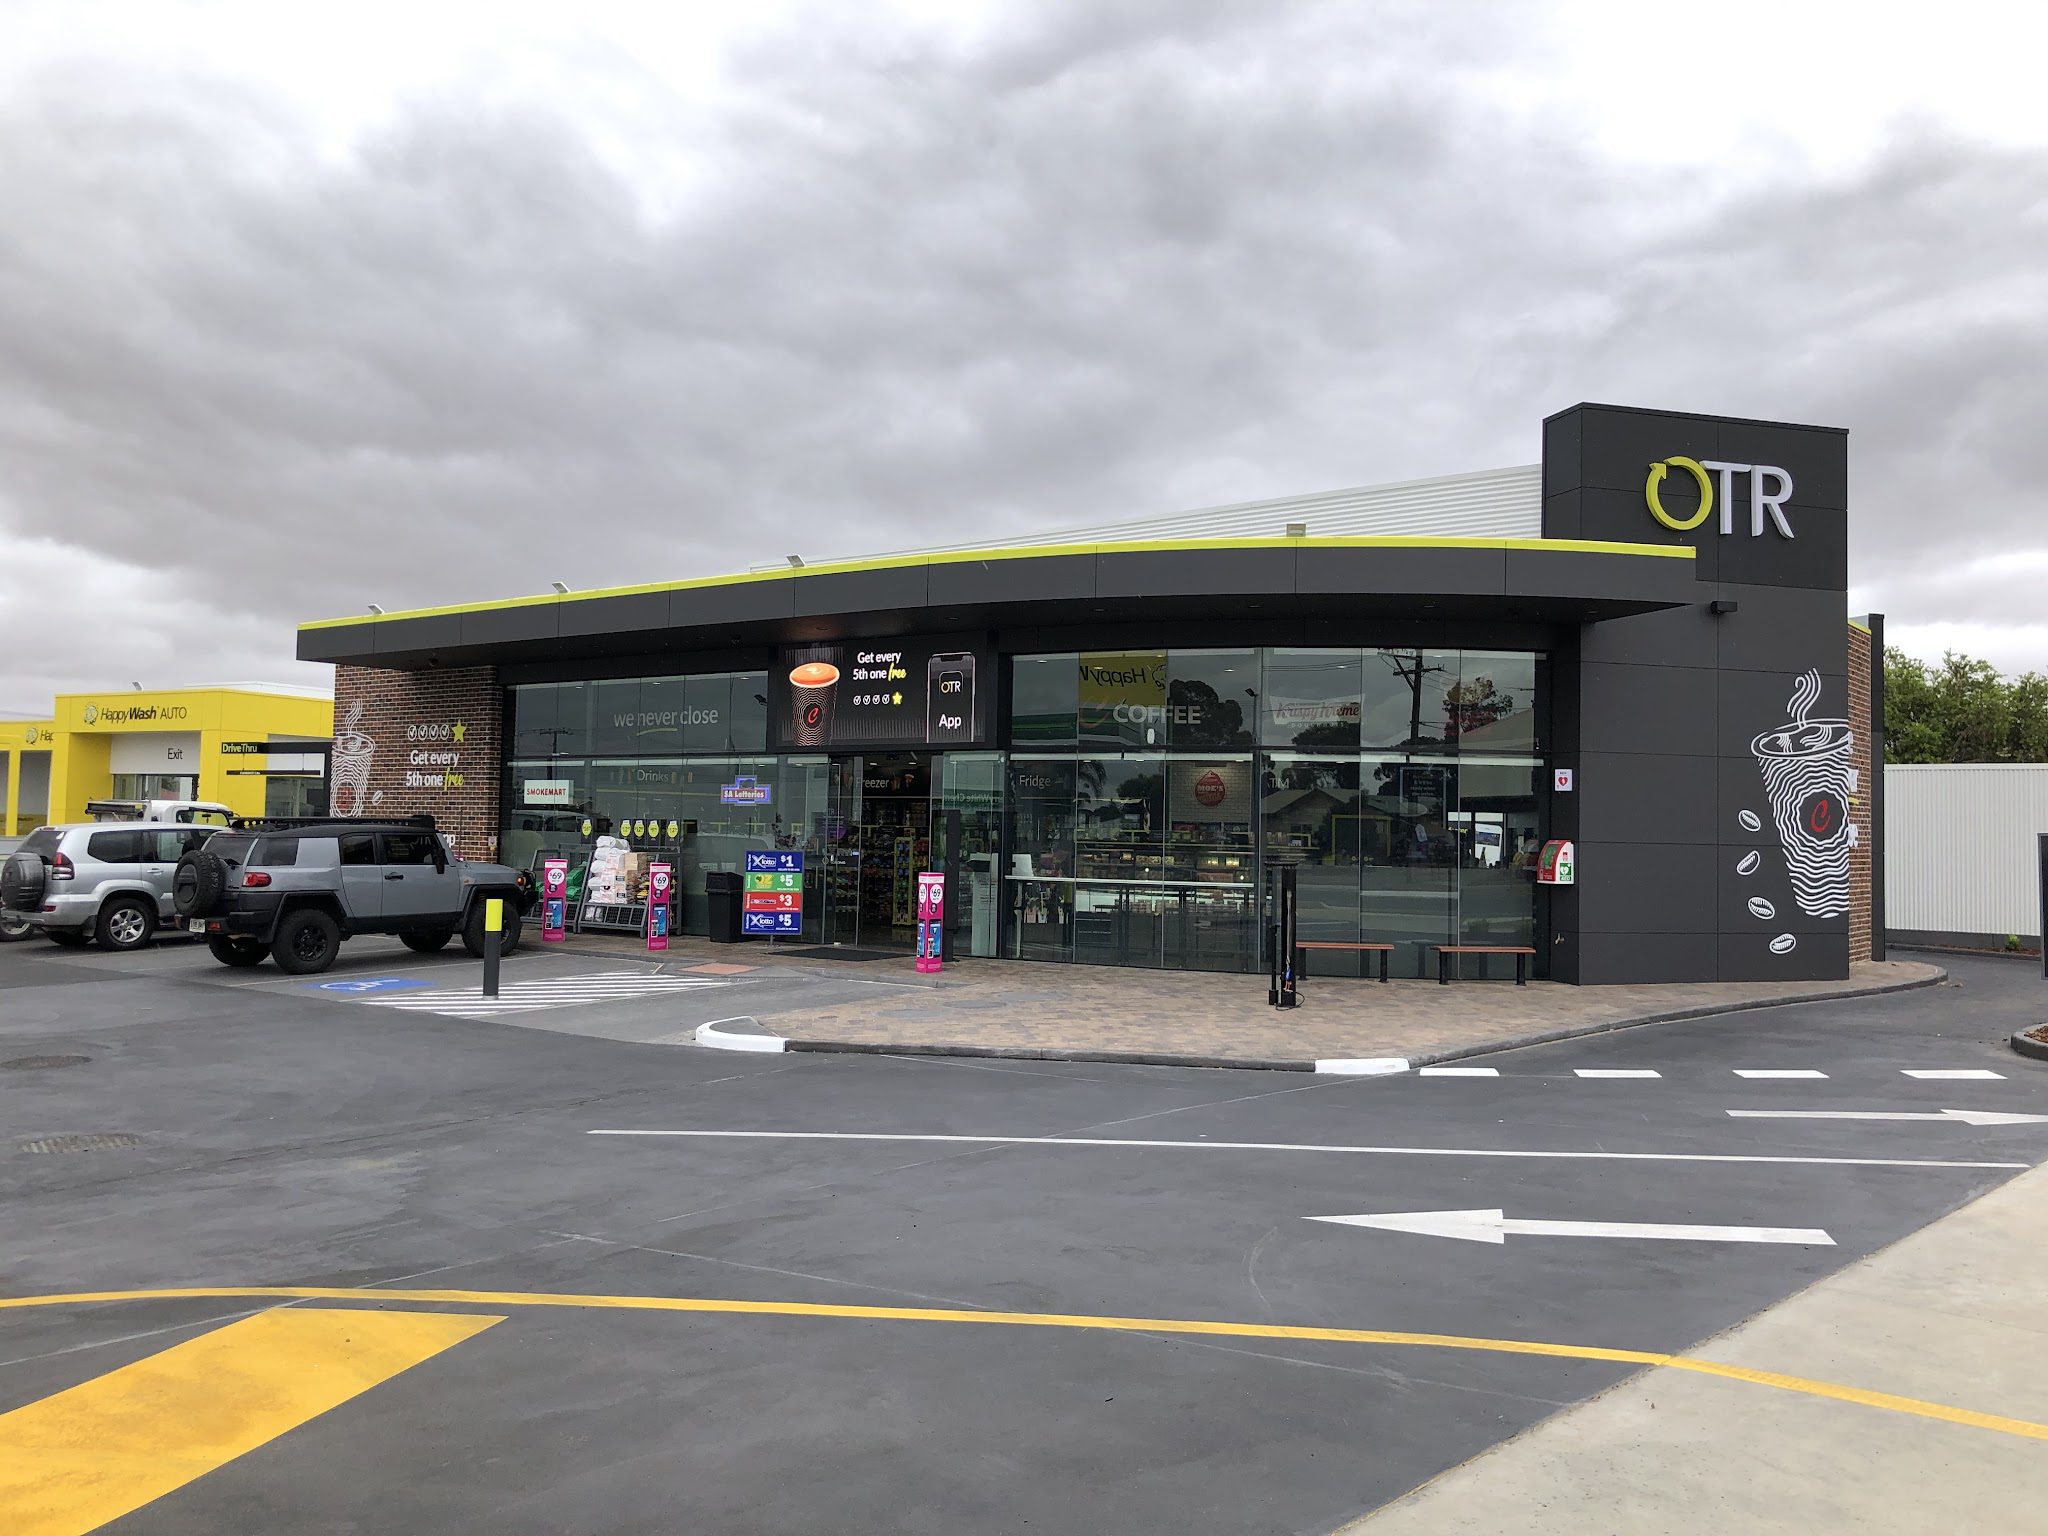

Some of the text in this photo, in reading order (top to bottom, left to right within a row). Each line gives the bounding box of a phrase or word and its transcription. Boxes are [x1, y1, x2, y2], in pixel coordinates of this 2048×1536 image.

[1646, 456, 1795, 539] OTR
[857, 652, 901, 664] Get every
[852, 662, 907, 681] 5th one free
[941, 681, 961, 693] OTR
[159, 707, 187, 720] AUTO
[614, 705, 719, 727] we never close
[1112, 704, 1201, 724] COFFEE
[939, 713, 961, 729] App
[167, 747, 183, 760] Exit
[222, 743, 258, 753] DriveThru
[410, 749, 459, 767] Get every
[406, 766, 465, 791] 5th one free
[637, 769, 669, 782] Drinks
[1019, 774, 1051, 790] Fridge
[526, 788, 567, 796] SMOKEMART
[724, 790, 764, 798] SA Lotteries
[780, 854, 794, 868] $1
[549, 872, 562, 880] $69
[655, 876, 667, 885] $69
[780, 874, 793, 887] $5
[779, 894, 793, 907] $3
[778, 914, 792, 927] $5
